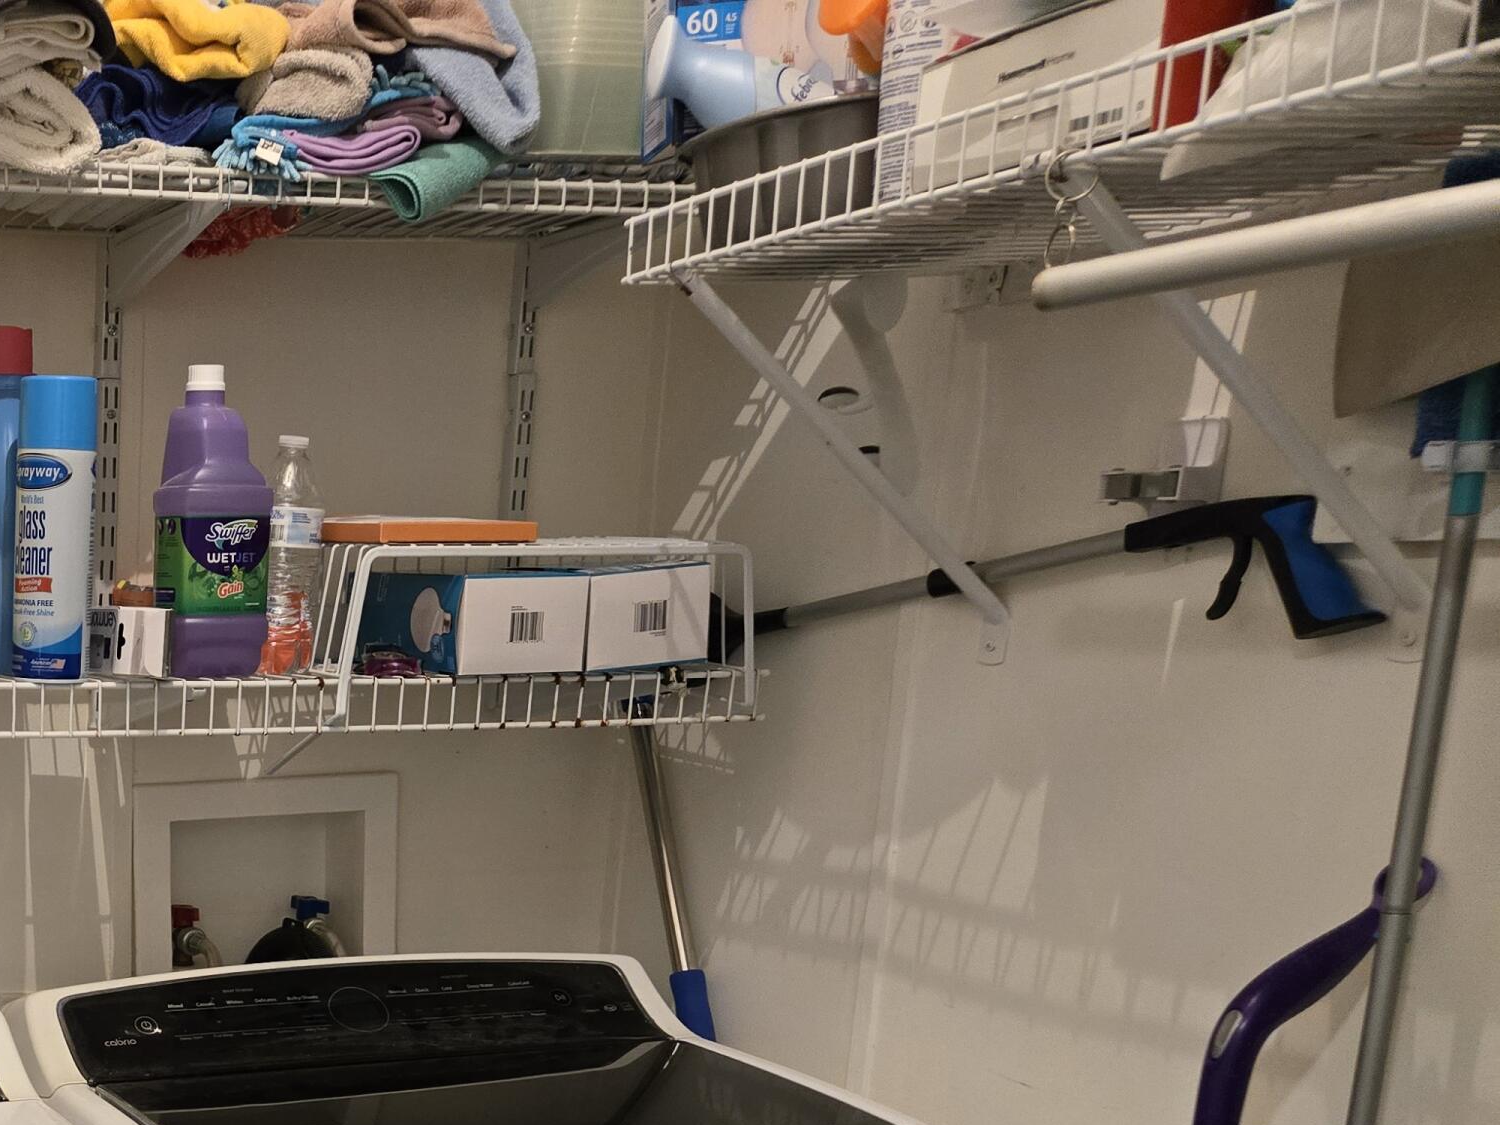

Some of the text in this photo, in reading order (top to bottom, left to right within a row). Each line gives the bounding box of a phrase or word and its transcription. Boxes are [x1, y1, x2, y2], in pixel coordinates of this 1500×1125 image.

[686, 9, 718, 35] 60
[791, 78, 819, 102] febr
[19, 505, 46, 544] glass
[205, 521, 257, 546] Swiffer
[216, 580, 245, 599] Gain
[103, 1037, 138, 1048] cabrio
